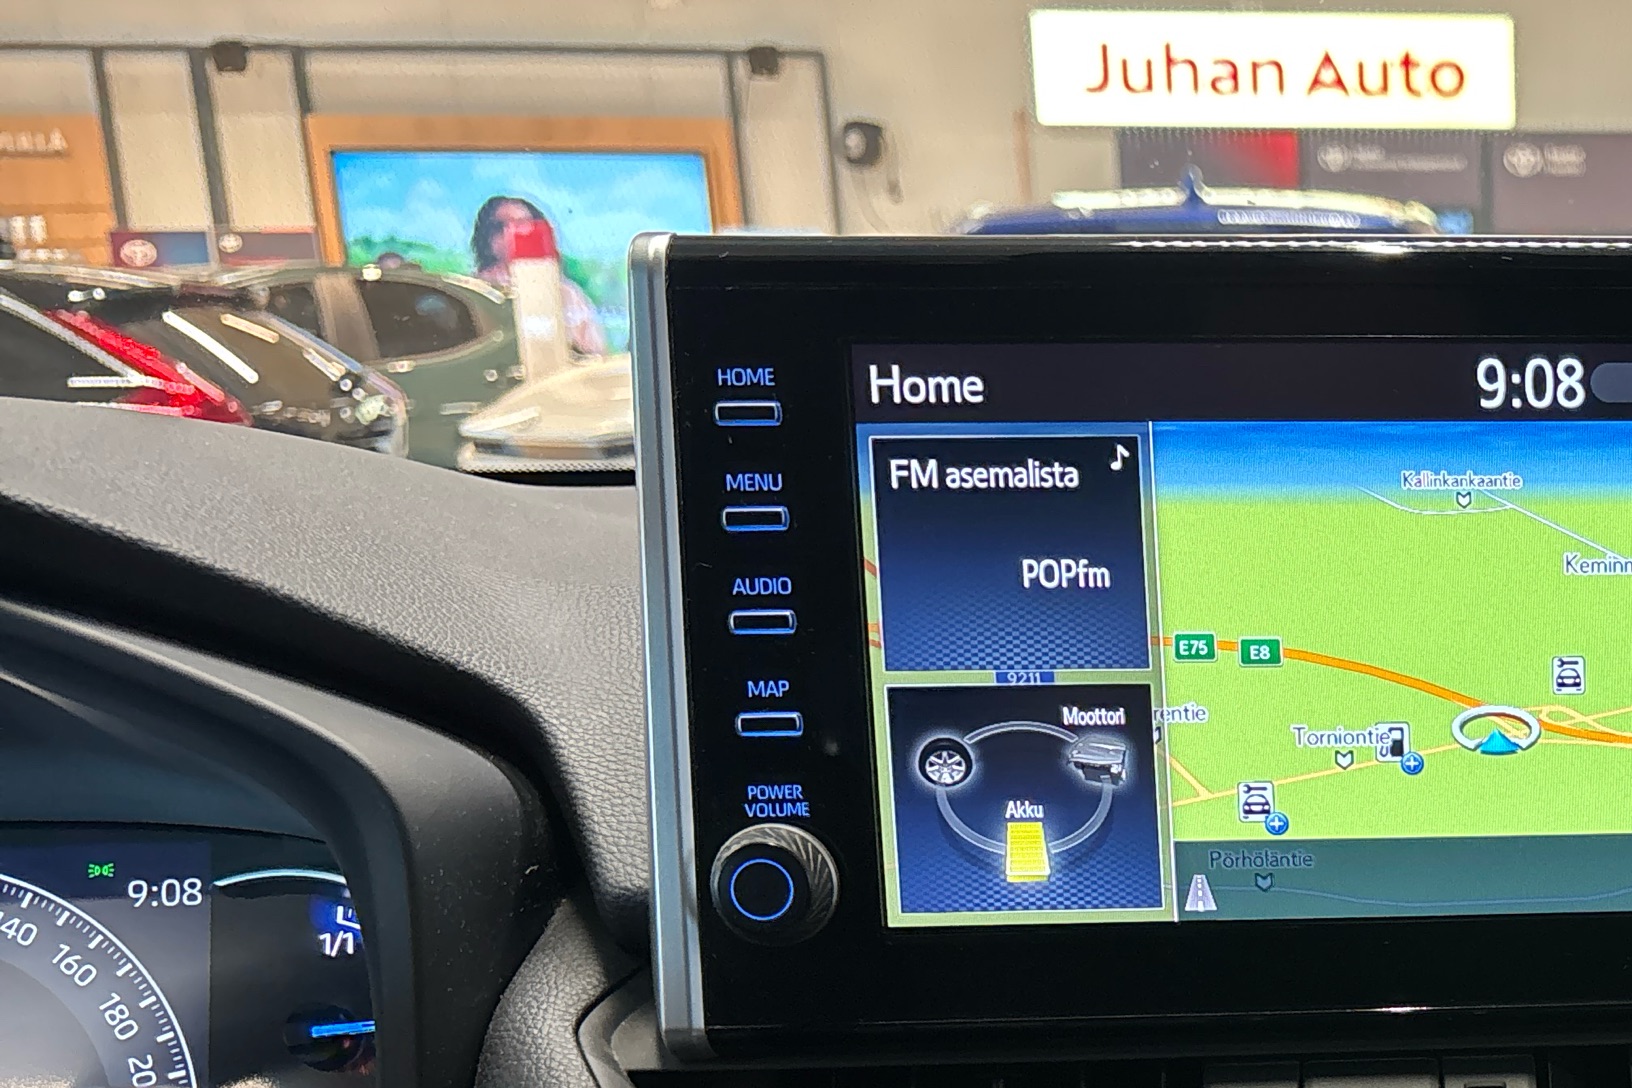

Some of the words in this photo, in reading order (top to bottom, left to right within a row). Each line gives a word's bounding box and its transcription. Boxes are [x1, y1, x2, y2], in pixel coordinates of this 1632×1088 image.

[1085, 41, 1286, 96] Juhan
[1306, 50, 1467, 98] Auto
[717, 367, 775, 386] HOME
[869, 364, 984, 404] Home
[1476, 357, 1586, 409] 9:08
[725, 473, 783, 492] MENU
[889, 458, 939, 490] FM
[945, 458, 1080, 489] asemalista
[1402, 472, 1521, 488] Kallinkankaantie
[1022, 558, 1111, 589] POPfm
[732, 576, 792, 595] AUDIO
[1179, 639, 1209, 656] E75
[1249, 644, 1271, 660] E8
[747, 679, 790, 698] MAP
[1062, 707, 1126, 726] Moottori
[1292, 727, 1391, 746] Torniontie
[747, 784, 803, 800] POWER
[744, 801, 810, 818] VOLUME
[1005, 800, 1046, 819] Akku
[127, 877, 203, 908] 9:08
[318, 930, 354, 957] 1/1
[51, 942, 98, 988] 160
[98, 992, 139, 1041] 180
[127, 1053, 157, 1088] 20
